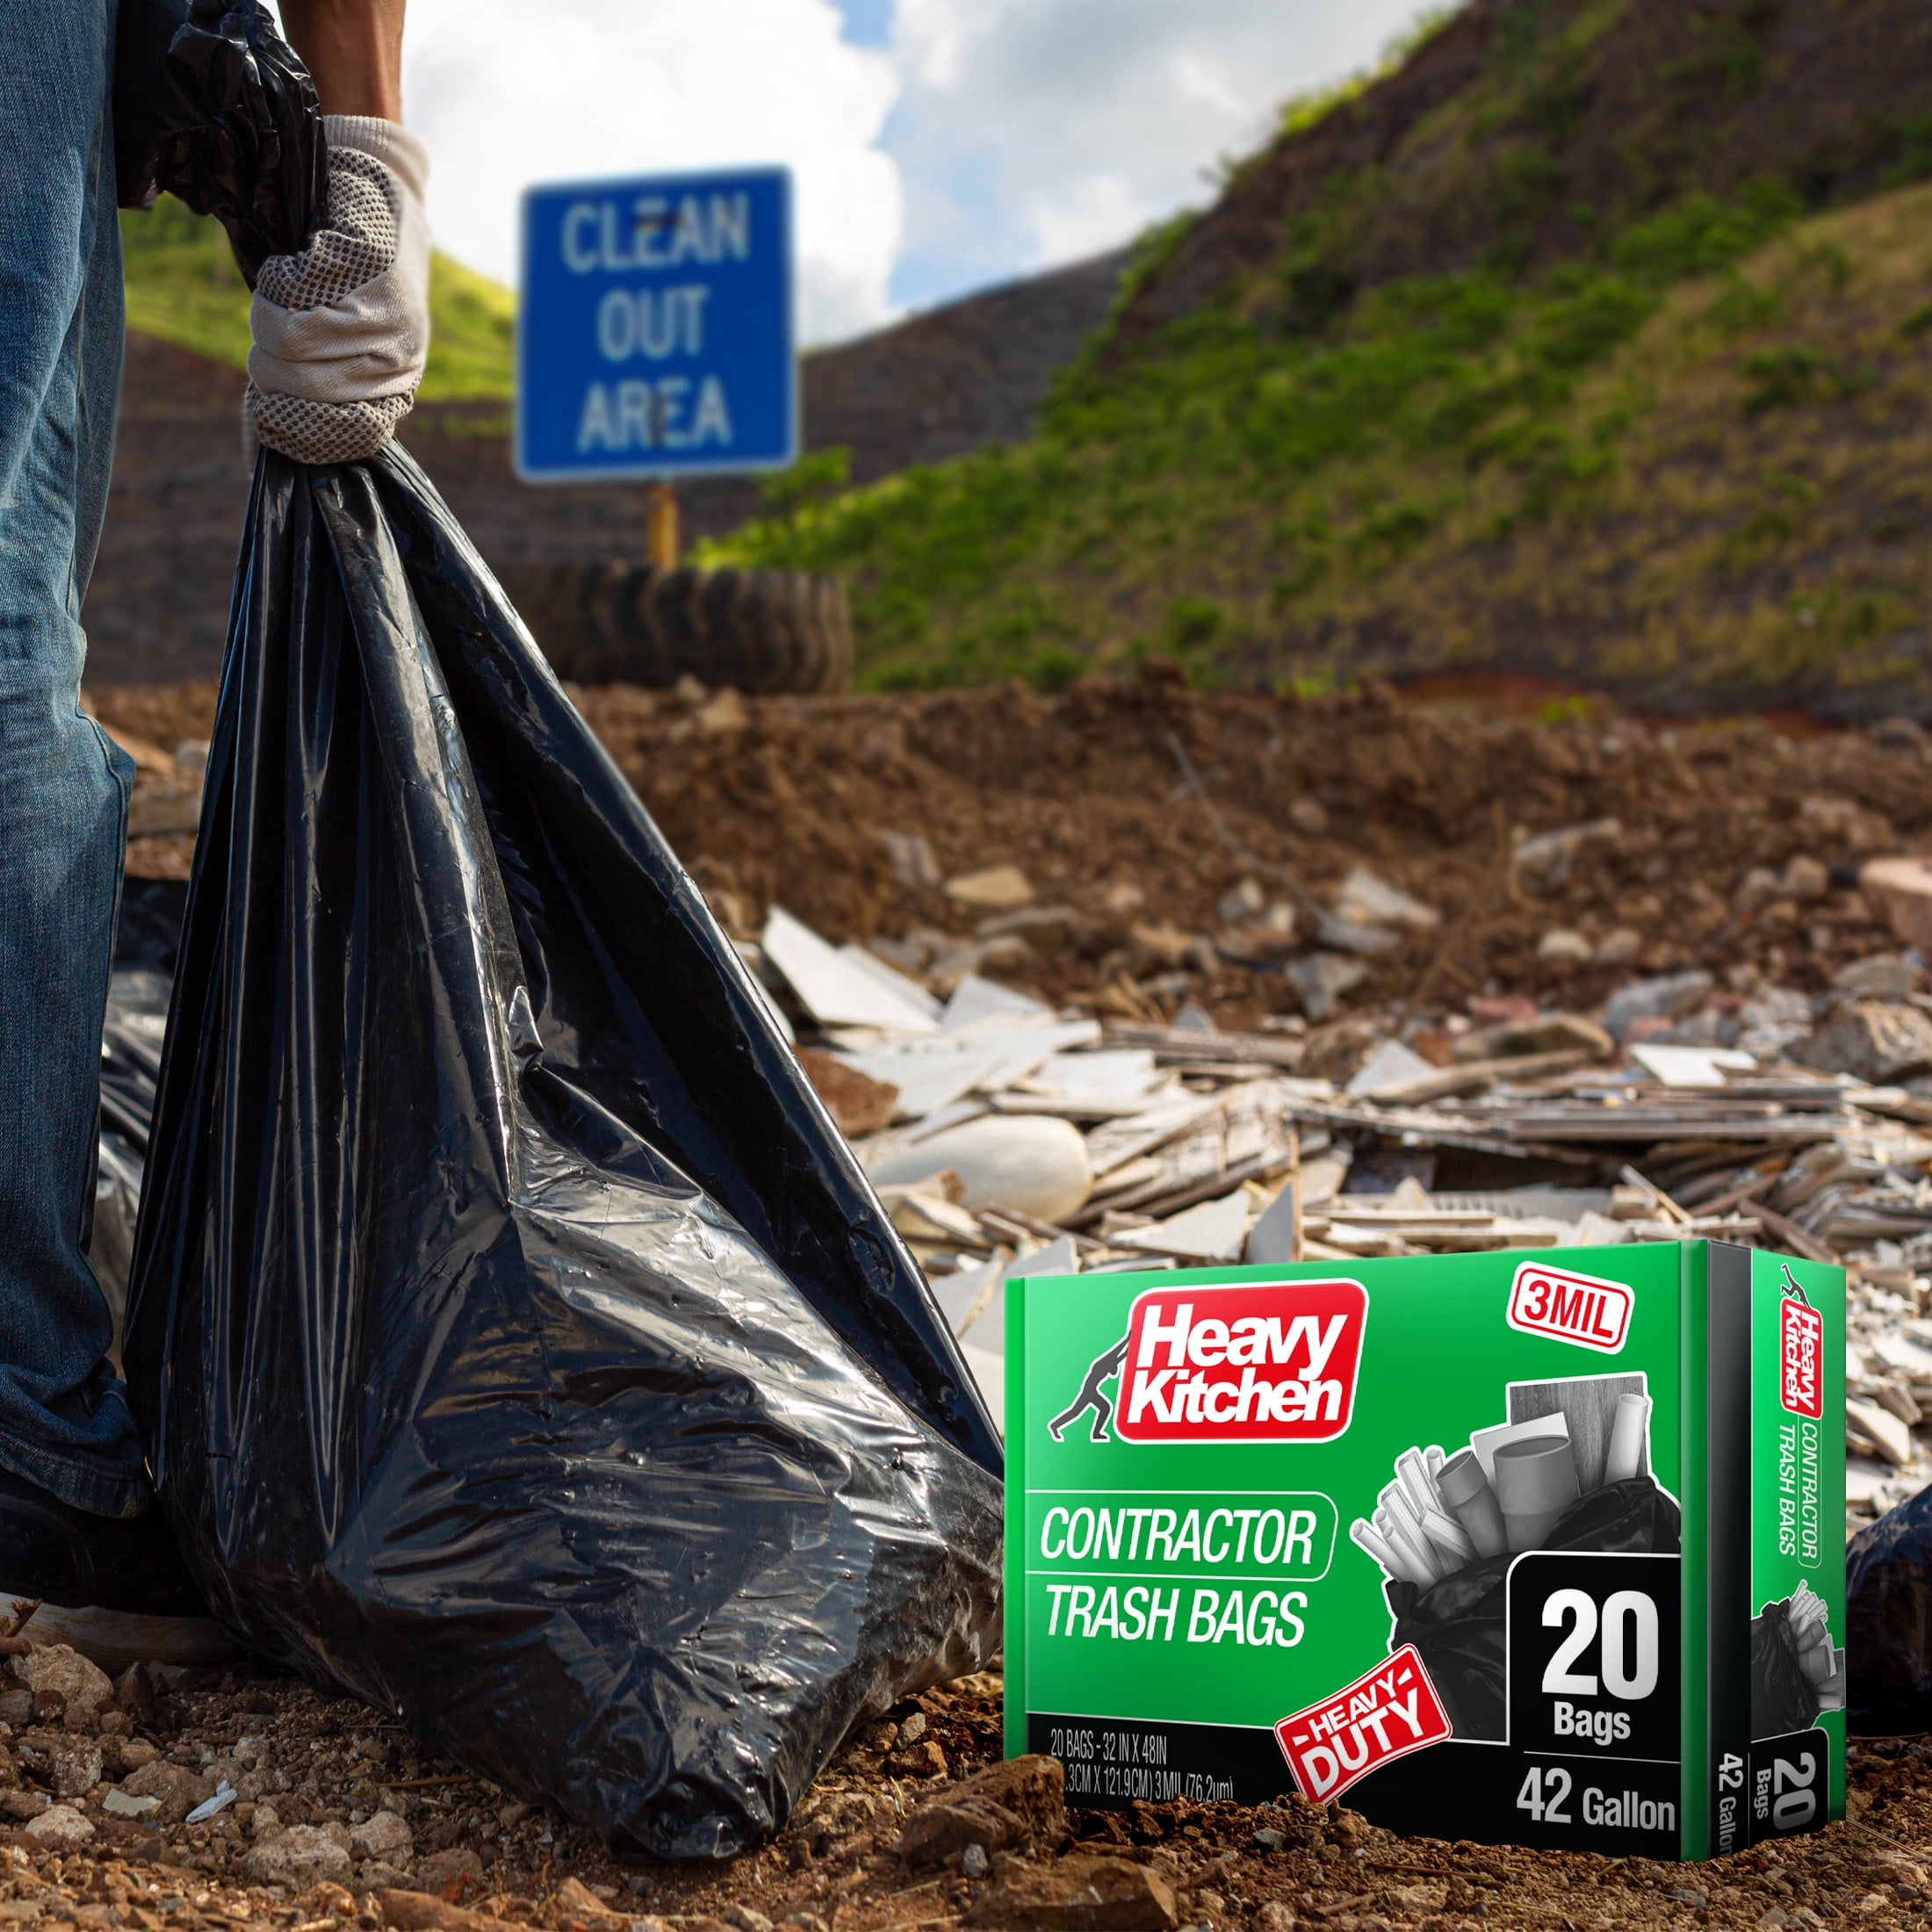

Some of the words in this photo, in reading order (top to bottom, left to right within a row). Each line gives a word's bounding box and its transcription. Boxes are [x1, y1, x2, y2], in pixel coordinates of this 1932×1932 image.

[561, 191, 749, 273] CLEAN
[597, 284, 711, 364] OUT
[576, 375, 732, 454] AREA
[1525, 1280, 1613, 1339] 3MIL
[1135, 1303, 1349, 1382] Heavy
[1784, 1305, 1801, 1408] Kitchen
[1797, 1307, 1820, 1411] Heavy
[1127, 1367, 1344, 1424] Kitchen
[1779, 1424, 1795, 1495] TRASH
[1802, 1422, 1818, 1560] CONTRACTOR
[1040, 1506, 1317, 1565] CONTRACTOR
[1779, 1498, 1795, 1557] BAGS
[1045, 1584, 1180, 1641] TRASH
[1186, 1590, 1308, 1648] BAGS
[1541, 1588, 1659, 1700] 20
[1050, 1728, 1063, 1756] 20
[1066, 1729, 1094, 1760] BAGS
[1103, 1732, 1116, 1762] 32
[1119, 1733, 1129, 1763] IN
[1132, 1734, 1139, 1763] X
[1142, 1734, 1167, 1765] 48IN
[1301, 1686, 1425, 1799] DUTY
[1554, 1701, 1632, 1747] Bags
[1093, 1765, 1101, 1794] X
[1103, 1766, 1152, 1802] 121.9CM)
[1517, 1767, 1572, 1824] 42
[1582, 1786, 1676, 1832] Gallon
[1719, 1753, 1743, 1792] 42
[1754, 1768, 1771, 1820] Bags
[1773, 1752, 1816, 1830] 20
[1719, 1796, 1736, 1856] Gallon
